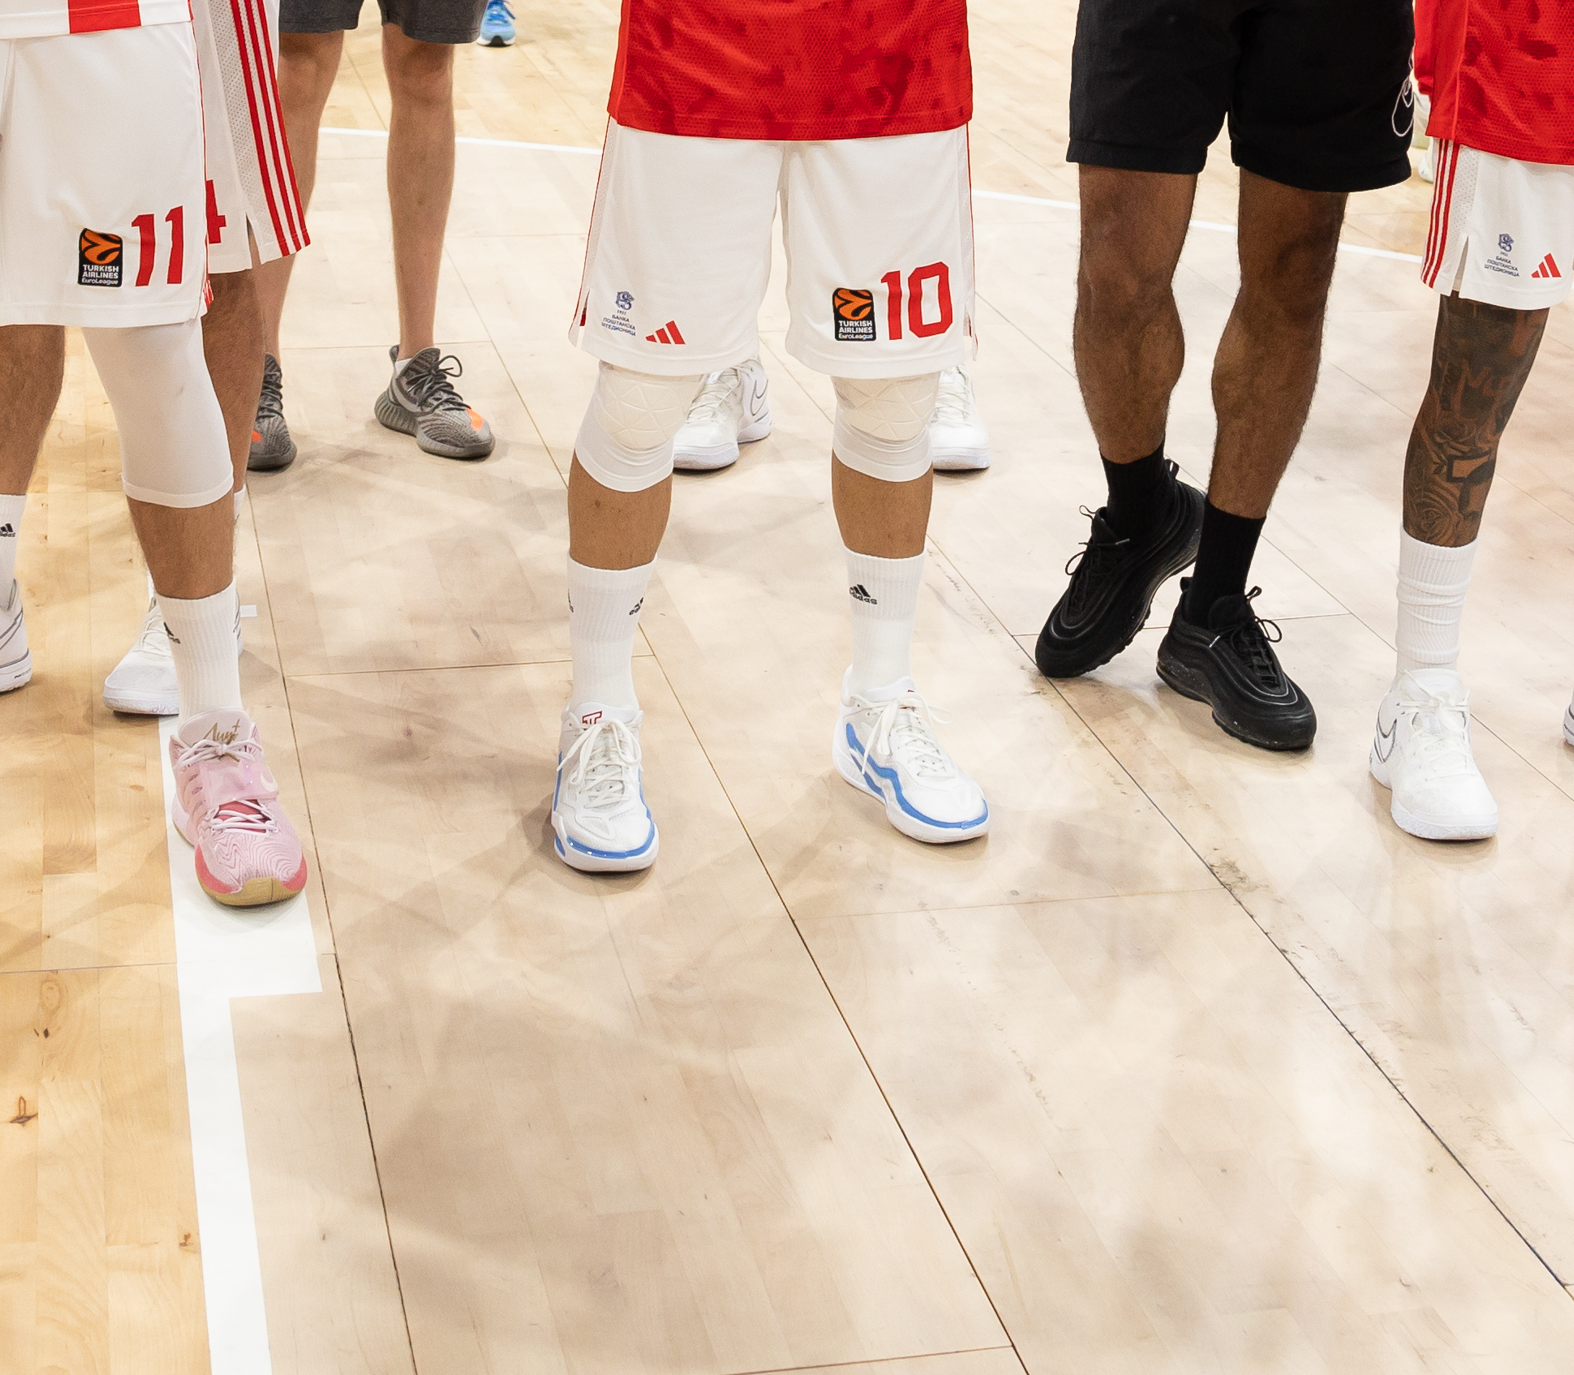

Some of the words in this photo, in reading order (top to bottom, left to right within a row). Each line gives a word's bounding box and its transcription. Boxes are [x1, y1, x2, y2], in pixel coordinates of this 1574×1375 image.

[83, 264, 119, 272] TURKISH
[131, 205, 185, 287] 11
[83, 271, 119, 279] AIRLINES
[880, 261, 953, 341] 10
